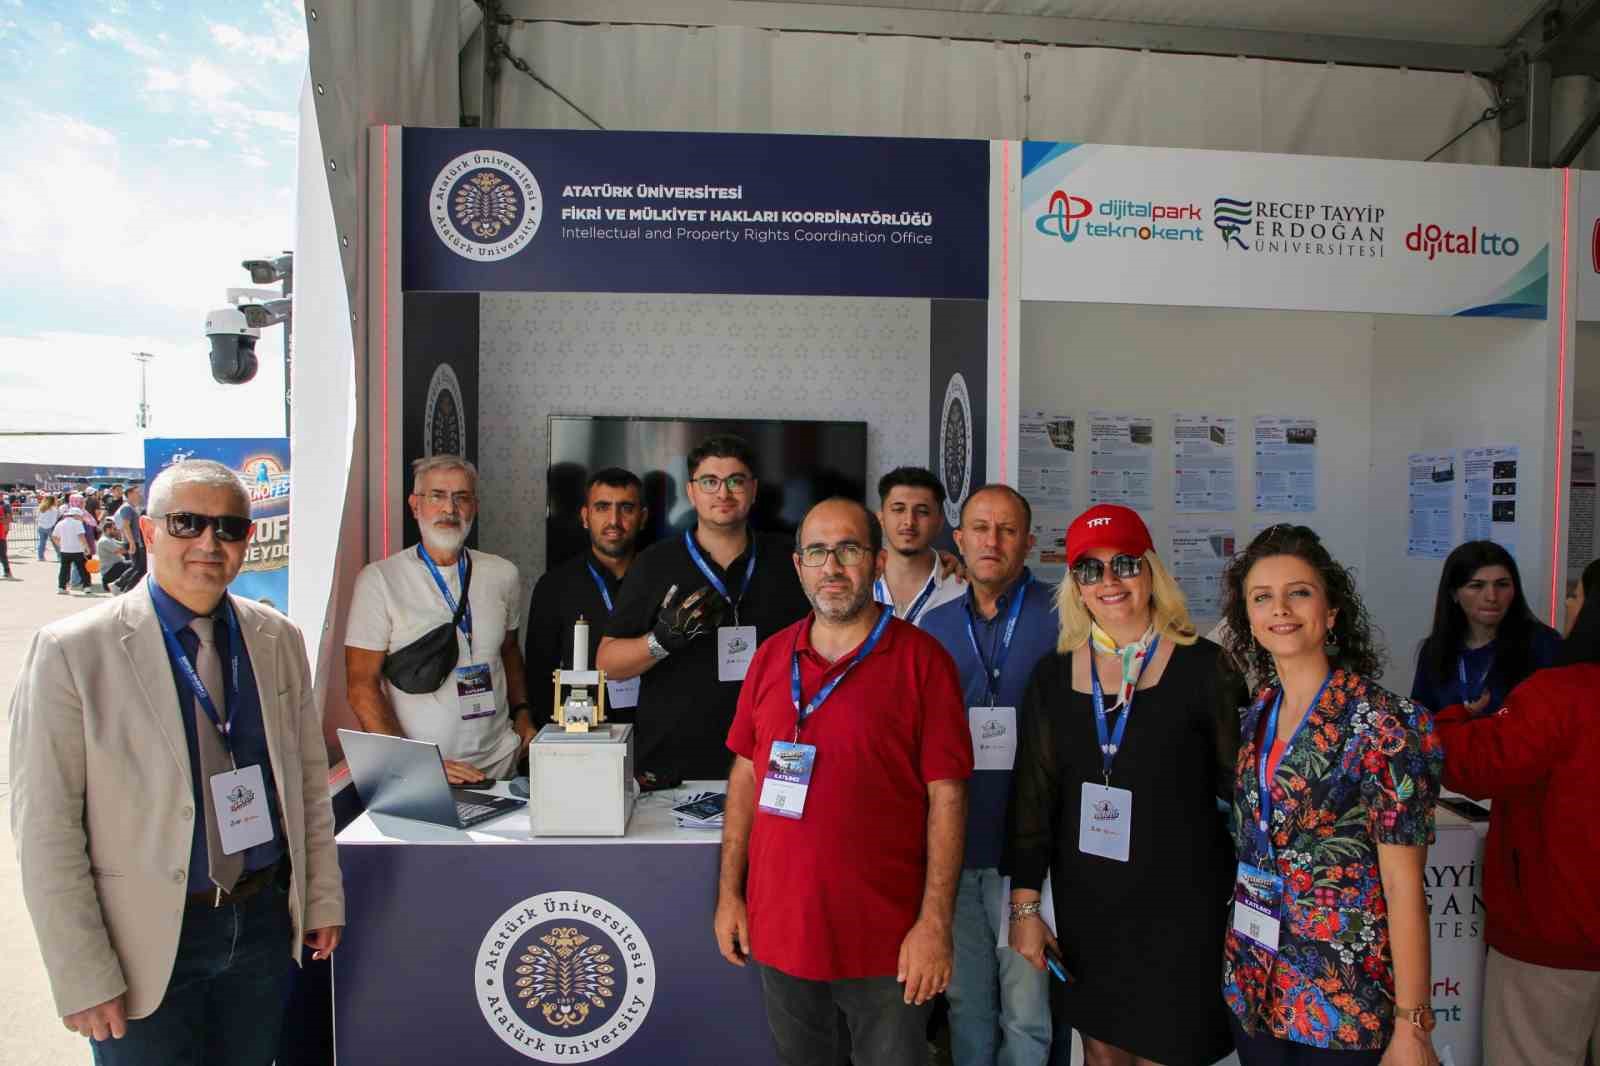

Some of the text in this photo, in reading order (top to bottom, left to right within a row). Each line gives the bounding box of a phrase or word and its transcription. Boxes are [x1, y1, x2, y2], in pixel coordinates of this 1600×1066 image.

[562, 184, 742, 199] ATATÜRK ÜNİVERSİTESİ
[562, 206, 932, 226] FİKRİ VE MÜLKİYET HAKLARI KOORDİNATÖRLÜĞÜ
[1100, 200, 1202, 222] dijitalpark
[1256, 202, 1385, 223] RECEP TAYYİP
[478, 218, 537, 256] University
[562, 226, 933, 245] Intellectual and Property Rights Coordination Office
[1086, 222, 1203, 241] teknokent
[1256, 221, 1384, 242] ERDOĞAN
[1087, 517, 1112, 528] TRT
[485, 898, 646, 970] Atatürk Üniversitesi
[487, 994, 645, 1055] Atatürk University
